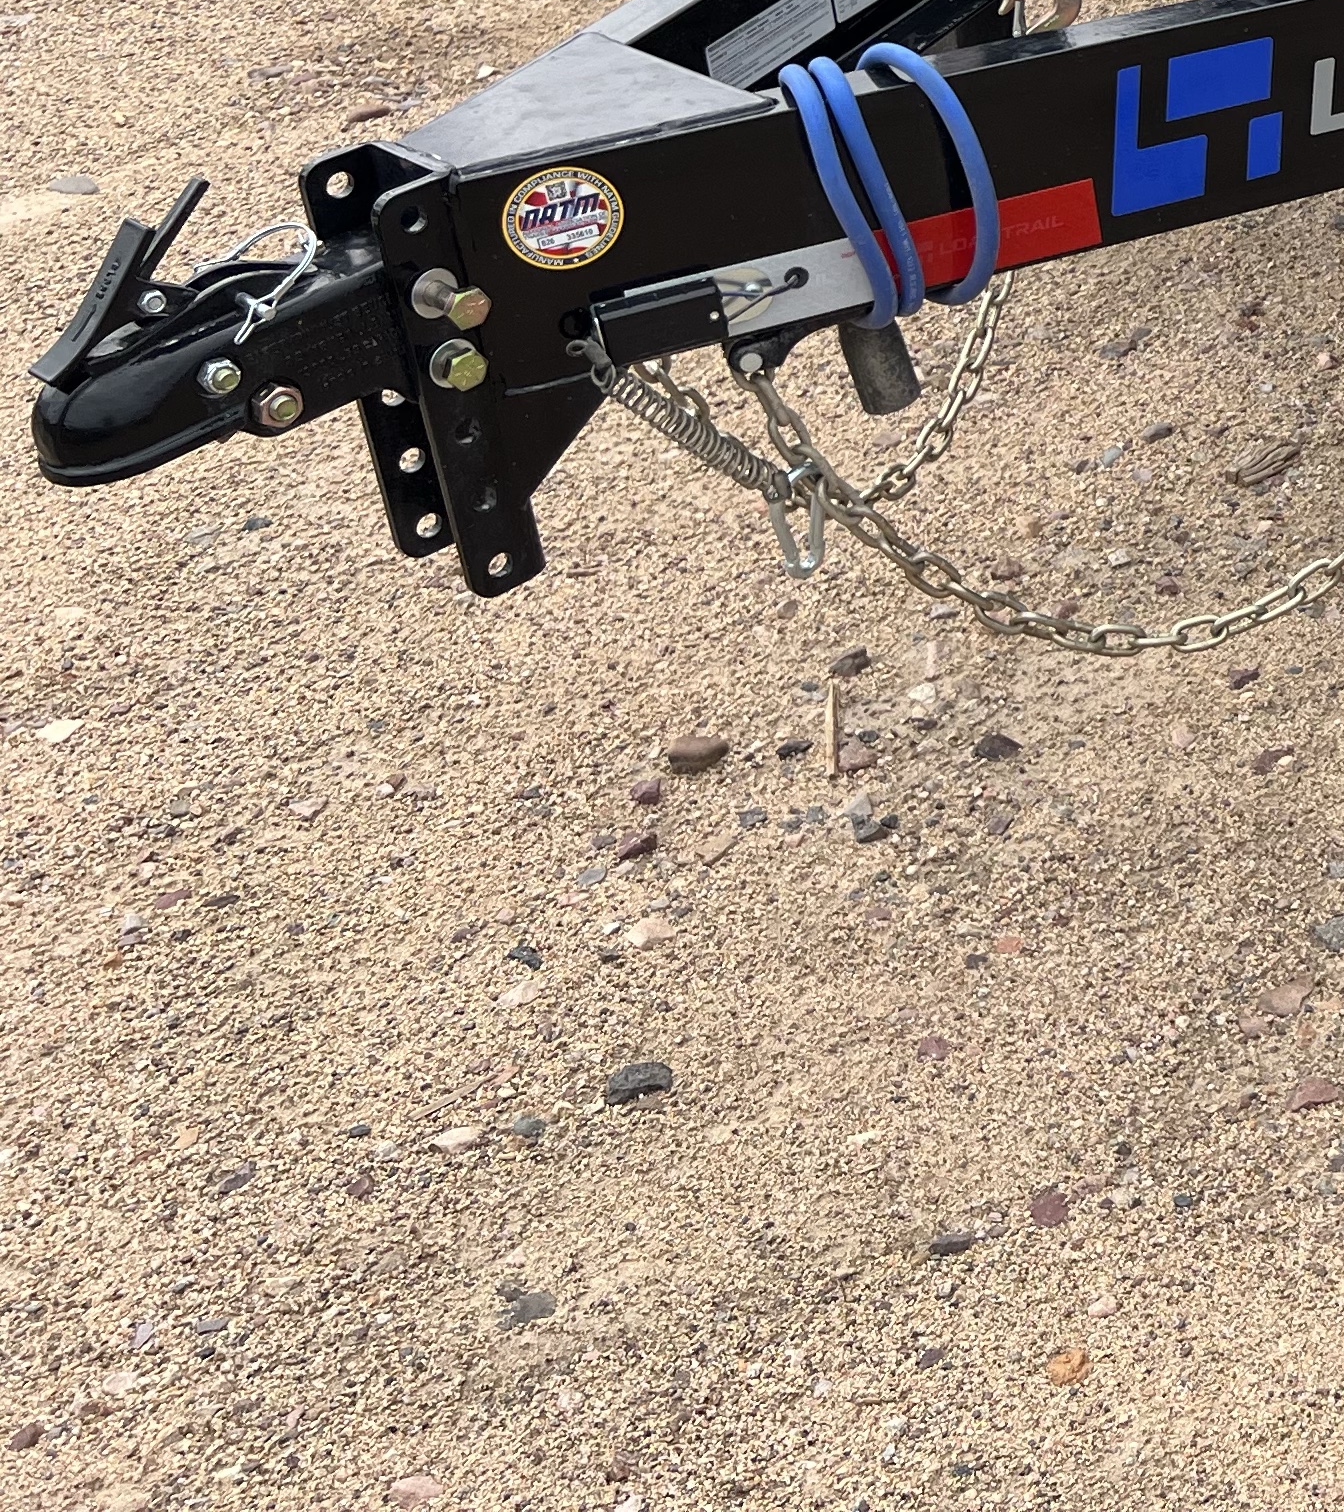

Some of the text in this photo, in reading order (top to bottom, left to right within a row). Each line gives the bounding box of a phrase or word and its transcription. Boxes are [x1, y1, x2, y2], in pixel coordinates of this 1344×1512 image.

[513, 170, 575, 203] COMPLIANCE
[577, 171, 602, 187] WITH
[1001, 215, 1065, 239] TRAIL
